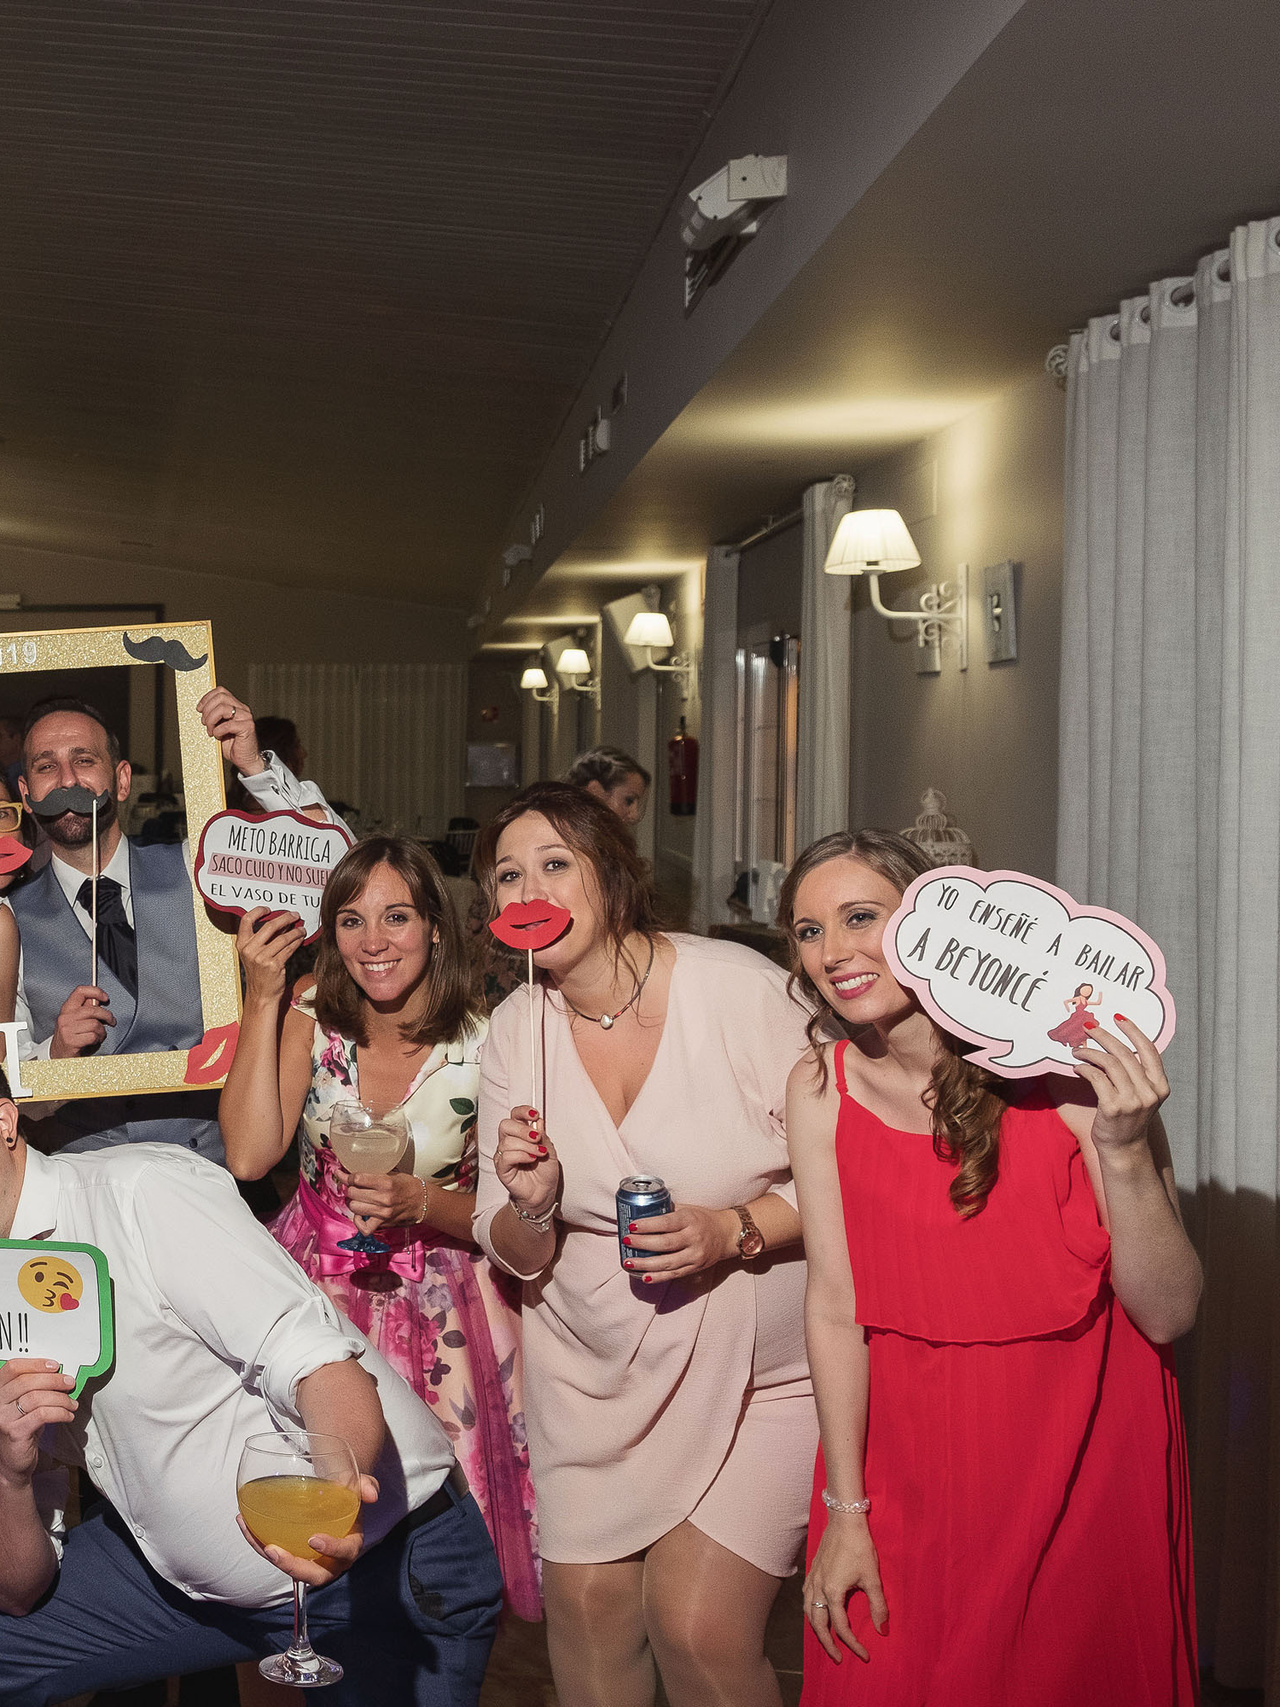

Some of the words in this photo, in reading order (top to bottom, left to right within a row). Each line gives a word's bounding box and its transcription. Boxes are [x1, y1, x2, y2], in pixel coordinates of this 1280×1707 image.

[228, 825, 266, 854] METO
[270, 831, 331, 863] BARRIGA
[211, 854, 242, 875] SACO
[245, 859, 275, 880] CULO
[277, 865, 286, 880] Y
[286, 866, 303, 883] NO
[211, 883, 226, 897] EL
[231, 885, 273, 903] VASO
[279, 892, 297, 905] DE
[302, 895, 321, 908] TU
[936, 883, 960, 911] YO
[969, 900, 1039, 945] ENSEÑÉ
[1046, 933, 1063, 956] A
[1075, 943, 1145, 992] BAILAR
[907, 927, 931, 962] A
[935, 937, 1049, 1012] BEYONCÉ
